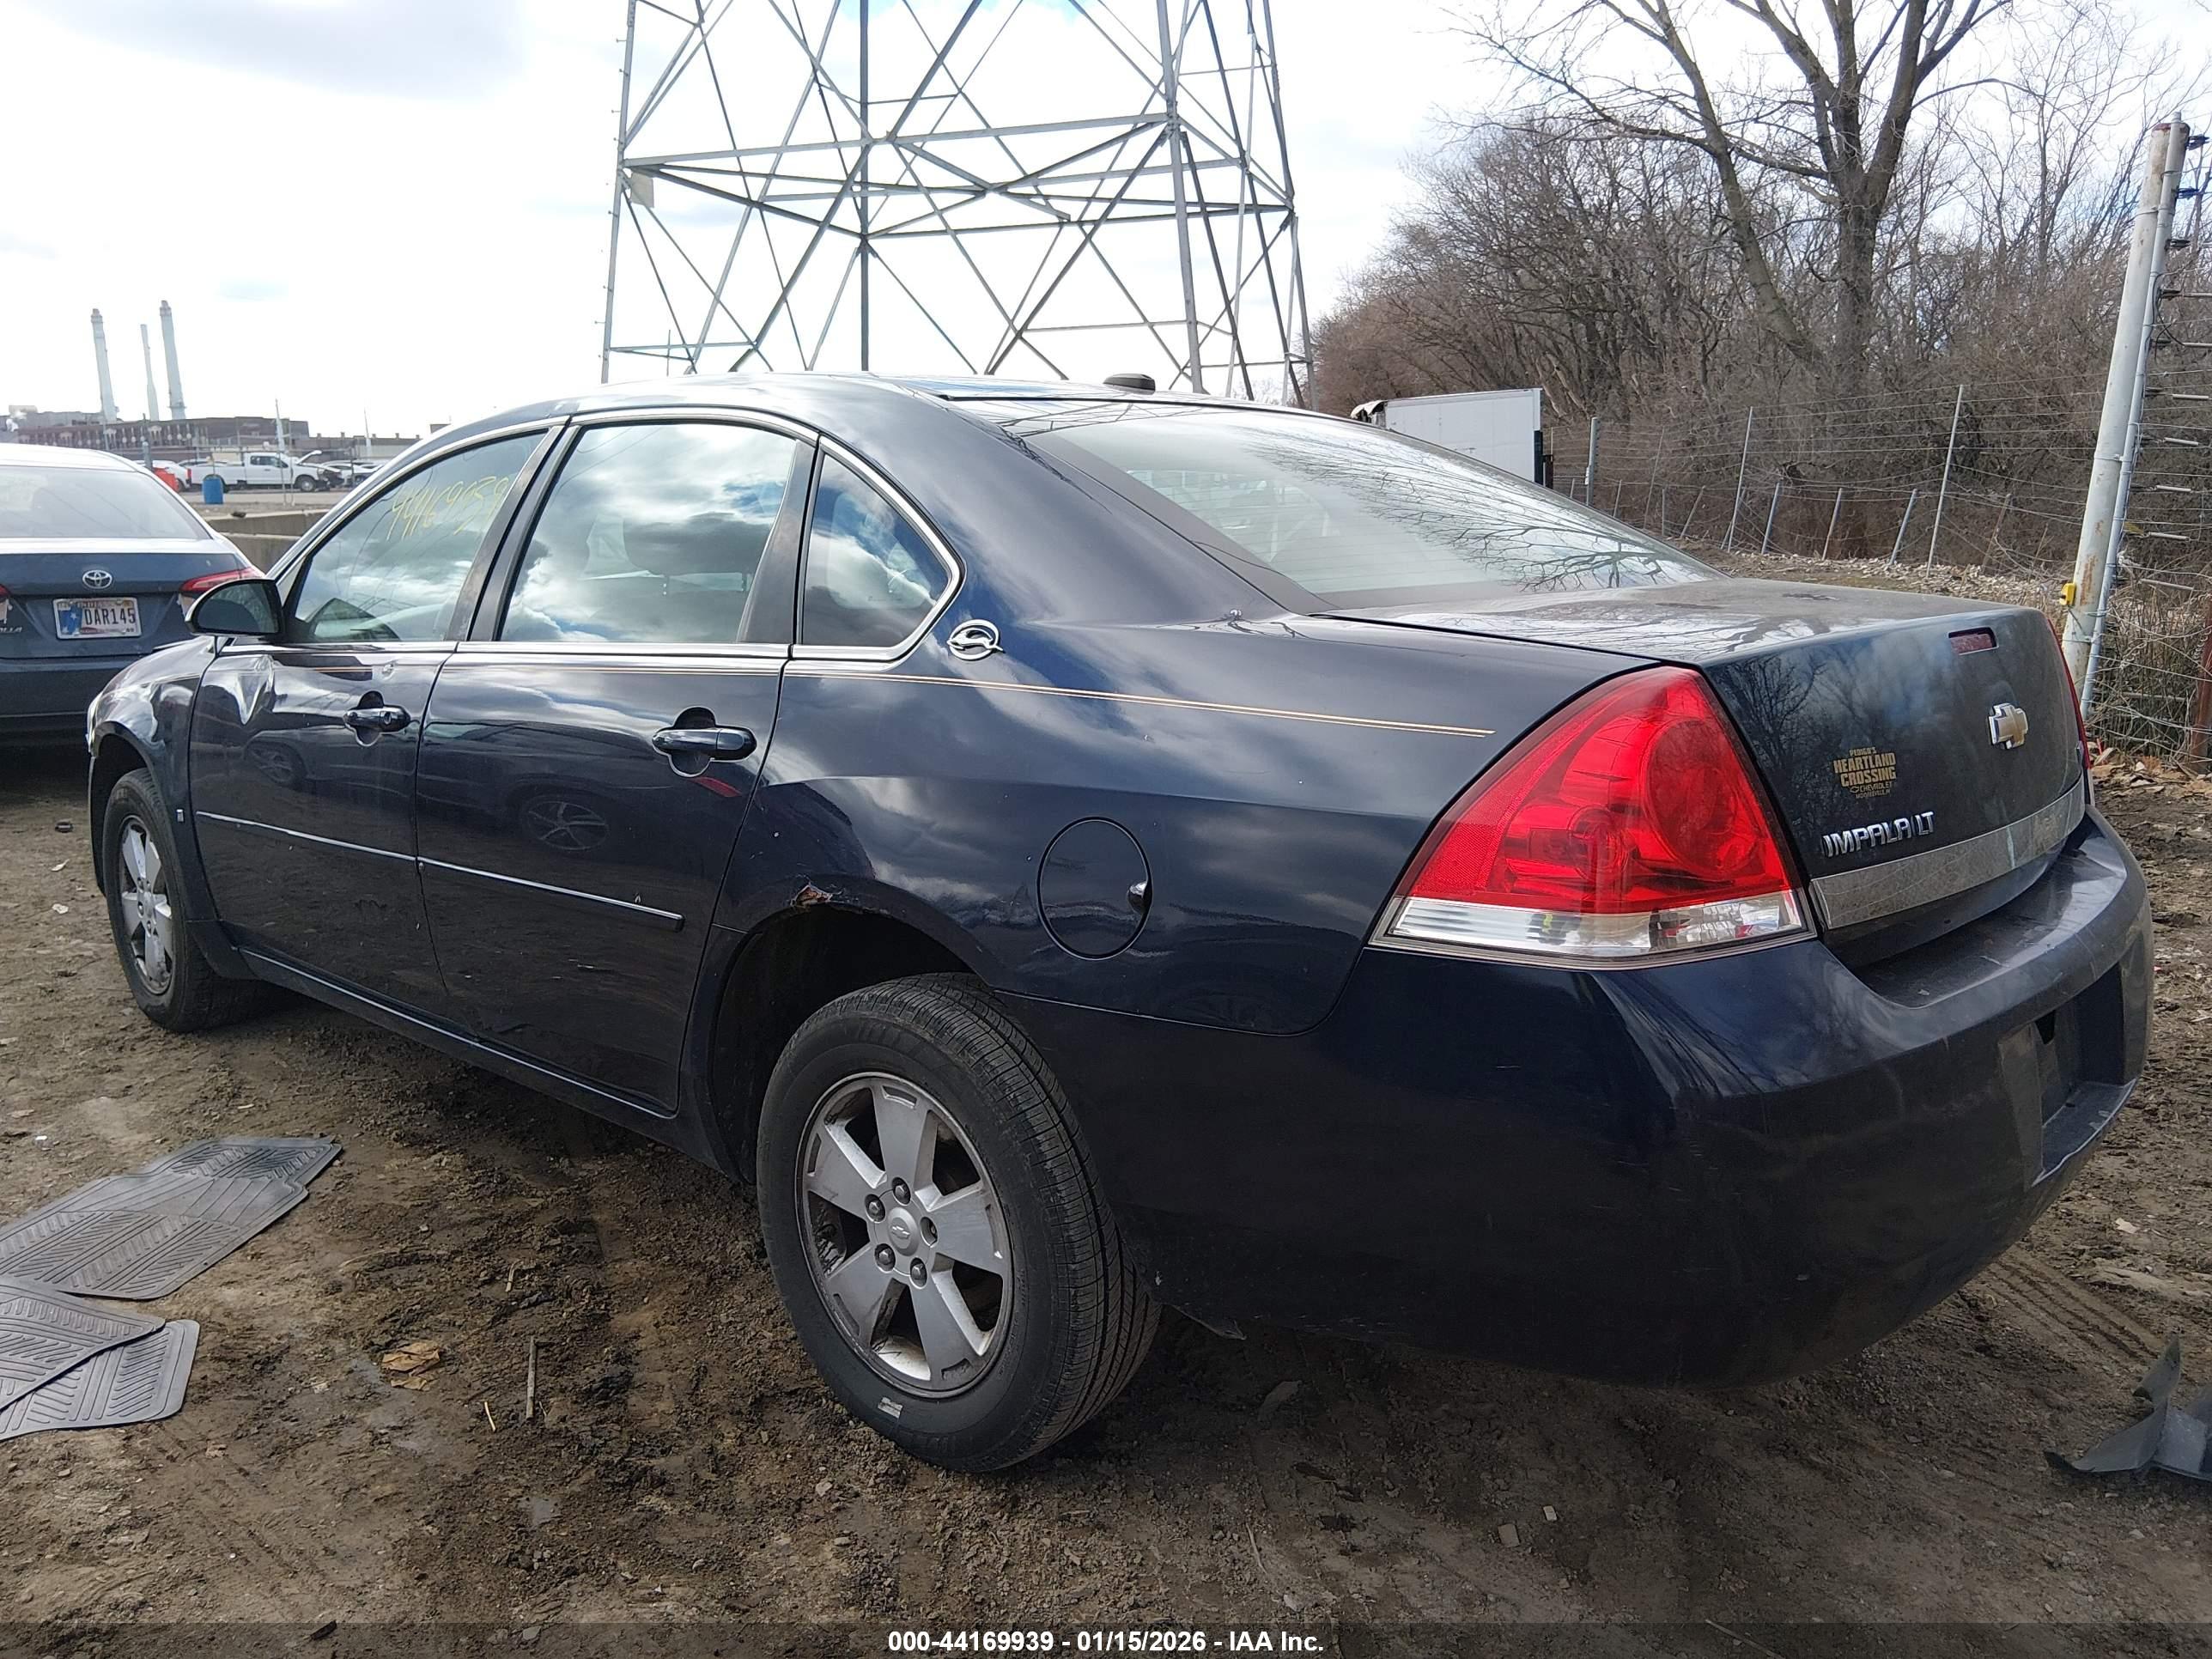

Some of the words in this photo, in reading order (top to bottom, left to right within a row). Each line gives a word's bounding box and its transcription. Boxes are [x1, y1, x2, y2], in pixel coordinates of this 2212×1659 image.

[84, 607, 137, 626] DAR145
[1833, 752, 1896, 774] HEARTLAND
[1840, 766, 1897, 787] CROSSING
[1821, 817, 1911, 858] IMPALA
[1914, 811, 1934, 836] LT
